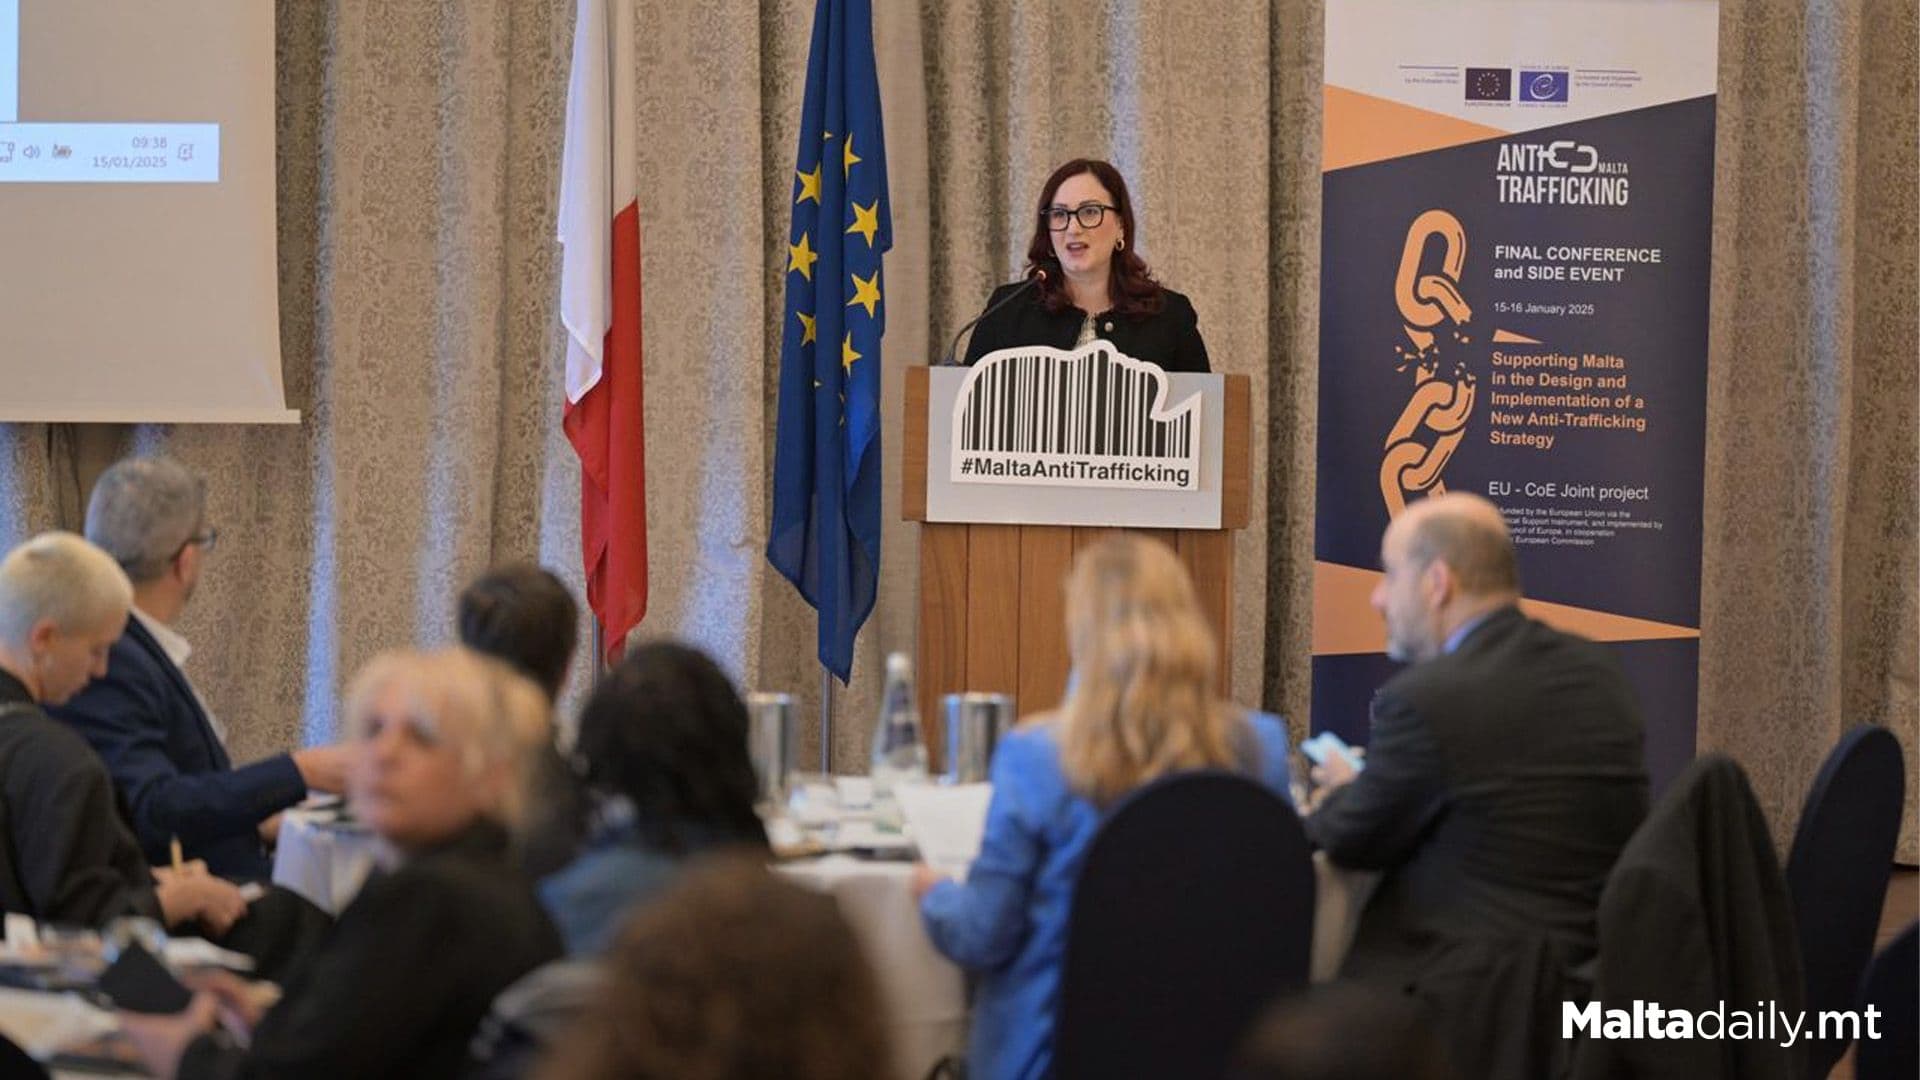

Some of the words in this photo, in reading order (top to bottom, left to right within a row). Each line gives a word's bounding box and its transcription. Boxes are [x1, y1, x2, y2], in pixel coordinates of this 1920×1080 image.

[132, 136, 167, 149] 09:38
[93, 156, 168, 169] 15/01/2025
[1497, 144, 1544, 172] ANTI
[1598, 163, 1628, 174] MALTA
[1496, 175, 1629, 206] TRAFFICKING
[1495, 245, 1542, 260] FINAL
[1546, 246, 1662, 263] CONFERENCE
[1494, 266, 1523, 279] and
[1527, 266, 1565, 280] SIDE
[1570, 268, 1624, 282] EVENT
[1494, 302, 1523, 313] 15-16
[1525, 303, 1566, 316] January
[1568, 304, 1594, 315] 2025
[1492, 352, 1578, 371] Supporting
[1583, 354, 1624, 369] Malta
[1492, 372, 1506, 385] in
[1511, 372, 1535, 386] the
[1540, 373, 1592, 390] Design
[1597, 376, 1627, 389] and
[1491, 392, 1610, 408] Implementation
[1615, 394, 1632, 408] of
[1634, 398, 1644, 409] a
[1490, 412, 1524, 426] New
[1527, 412, 1646, 432] Anti-Trafficking
[1490, 430, 1554, 449] Strategy
[961, 458, 1190, 487] #MaltaAntiTrafficking
[1488, 481, 1511, 496] EU
[1524, 482, 1557, 498] CoE
[1560, 484, 1595, 499] Joint
[1599, 486, 1649, 502] project
